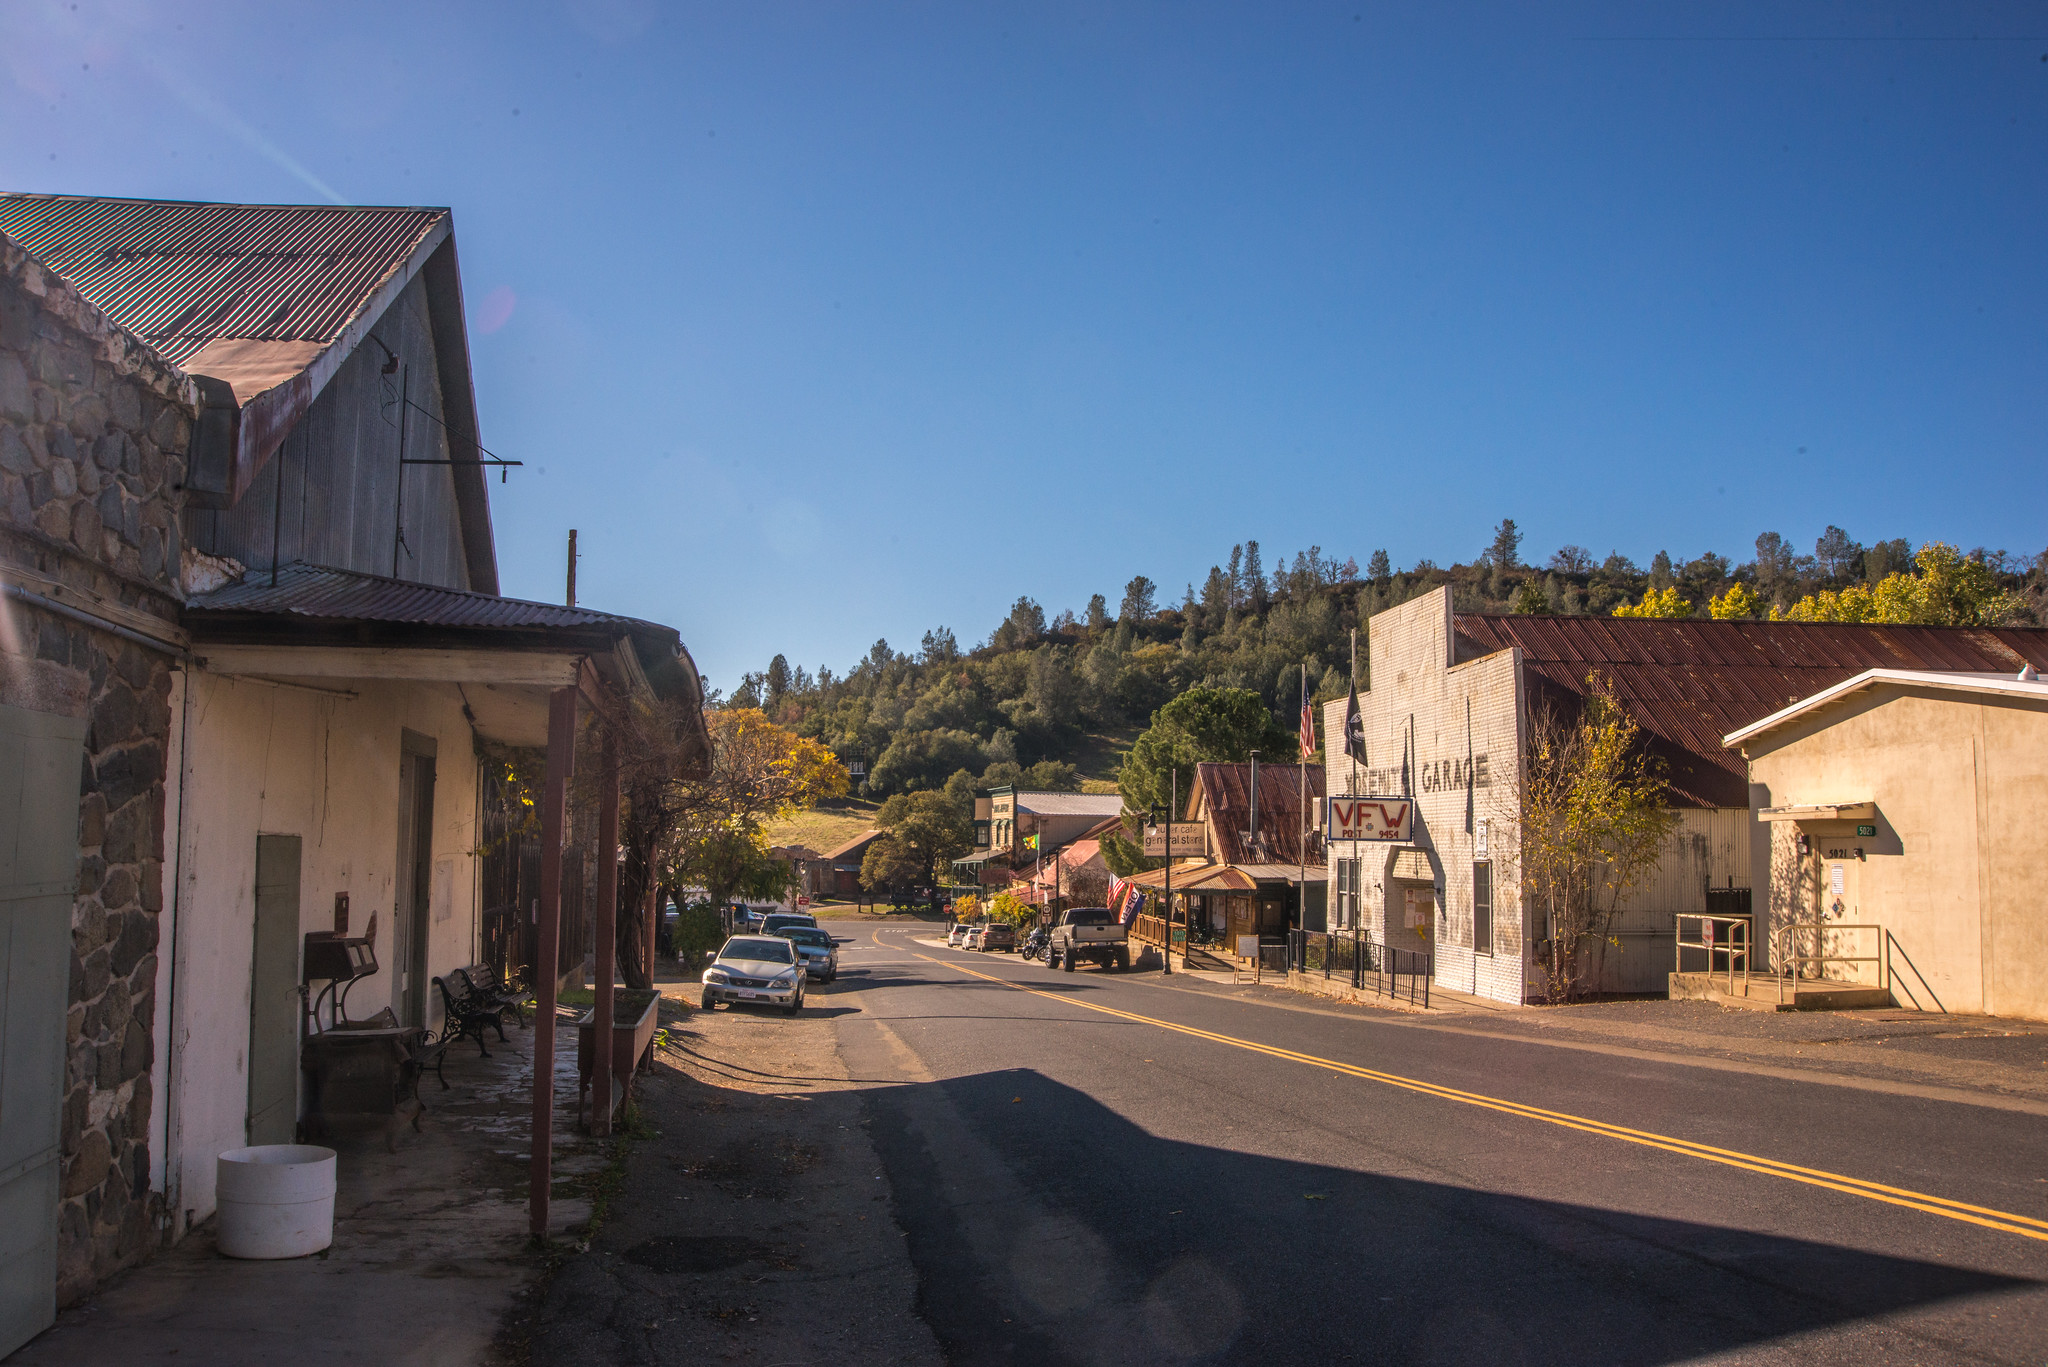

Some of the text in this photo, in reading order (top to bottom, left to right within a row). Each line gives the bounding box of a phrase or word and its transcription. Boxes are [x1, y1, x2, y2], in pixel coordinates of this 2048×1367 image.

[1422, 752, 1490, 793] GARAGE
[1334, 802, 1408, 828] VFW
[1378, 830, 1399, 839] 9454
[1859, 826, 1873, 835] 5021
[1829, 848, 1846, 858] 5021
